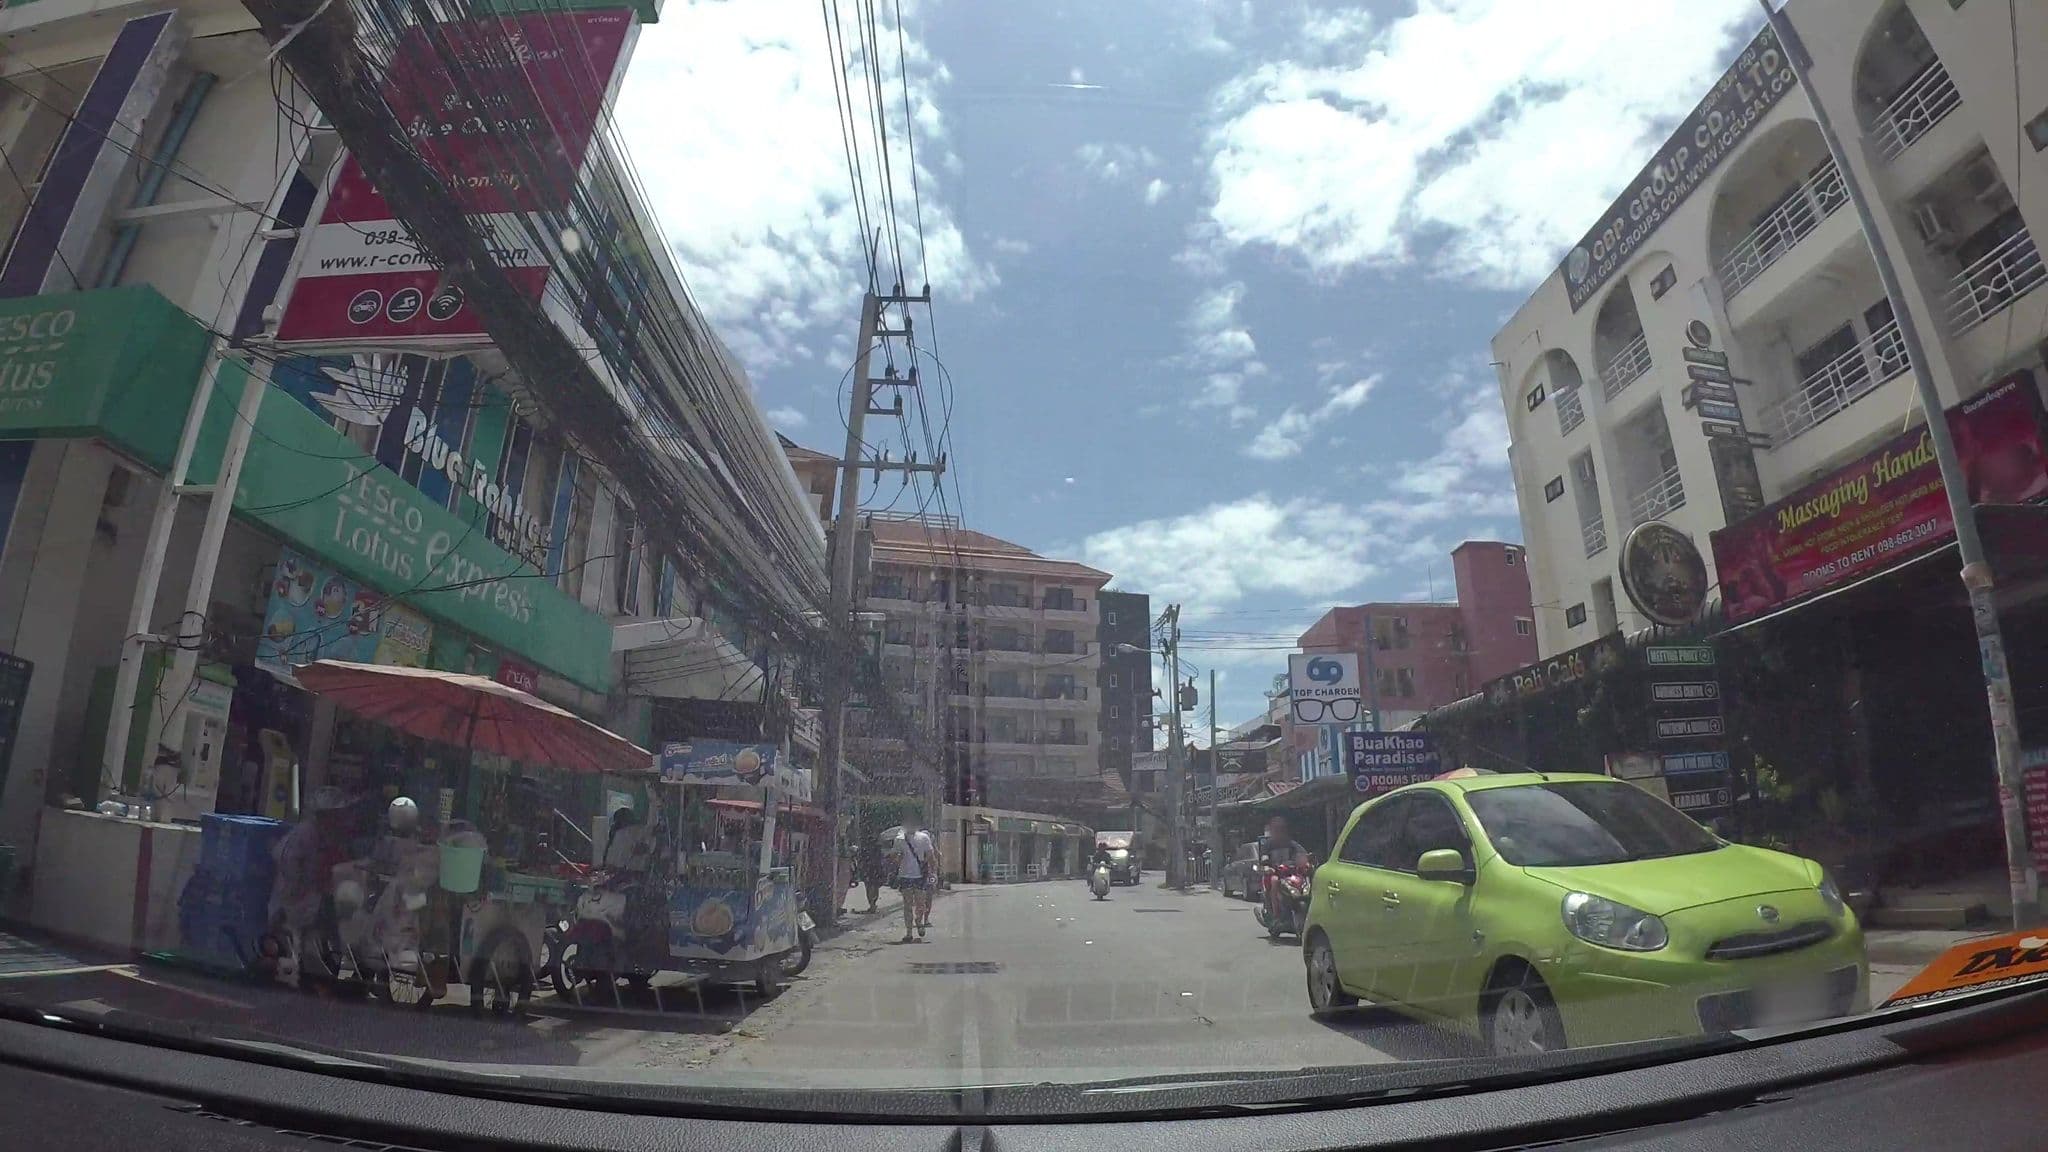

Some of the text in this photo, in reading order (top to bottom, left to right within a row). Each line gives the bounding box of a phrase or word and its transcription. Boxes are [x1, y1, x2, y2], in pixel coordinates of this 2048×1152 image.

[1629, 146, 1689, 222] GROUP
[1778, 473, 1869, 534] Massaging
[1872, 431, 1937, 488] Hands
[344, 460, 424, 533] TESCO
[335, 507, 415, 581] Lotus
[425, 530, 531, 624] express
[1837, 555, 1851, 571] TO
[1850, 544, 1876, 565] RENT
[1294, 687, 1361, 697] TOP CHAROEN
[1353, 735, 1424, 750] BuaKhao
[1354, 750, 1425, 765] Paradise
[1371, 774, 1409, 786] ROOMS
